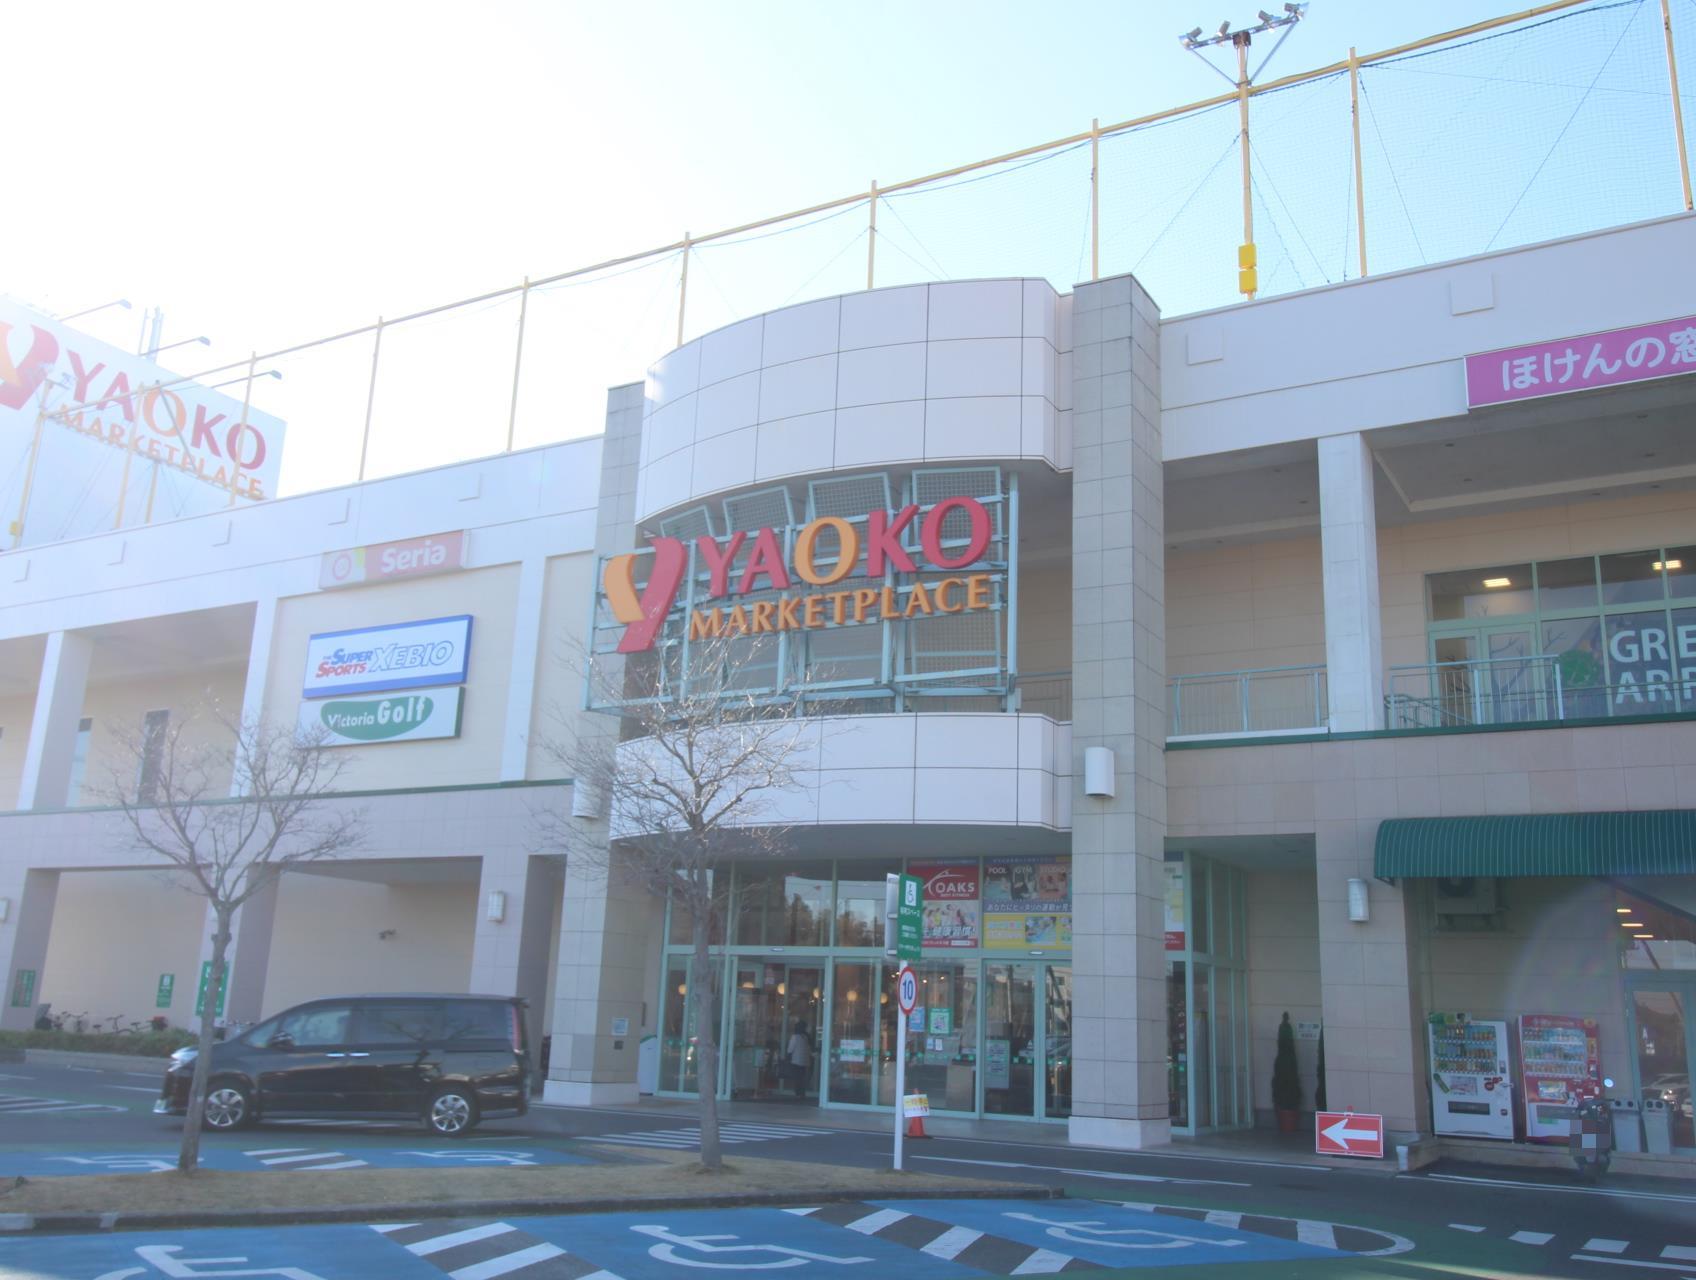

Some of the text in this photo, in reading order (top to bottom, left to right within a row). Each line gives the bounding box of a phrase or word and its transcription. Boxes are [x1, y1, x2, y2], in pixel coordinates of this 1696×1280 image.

[66, 349, 267, 471] YAOKO
[381, 540, 447, 573] Seria
[696, 496, 992, 599] YAOKO
[689, 574, 991, 641] MARKETPLACE
[315, 660, 367, 678] SPORTS
[368, 640, 455, 673] XEBIO
[328, 696, 427, 728] Victoria Golf
[936, 882, 975, 893] OAKS
[902, 980, 913, 1001] 10
